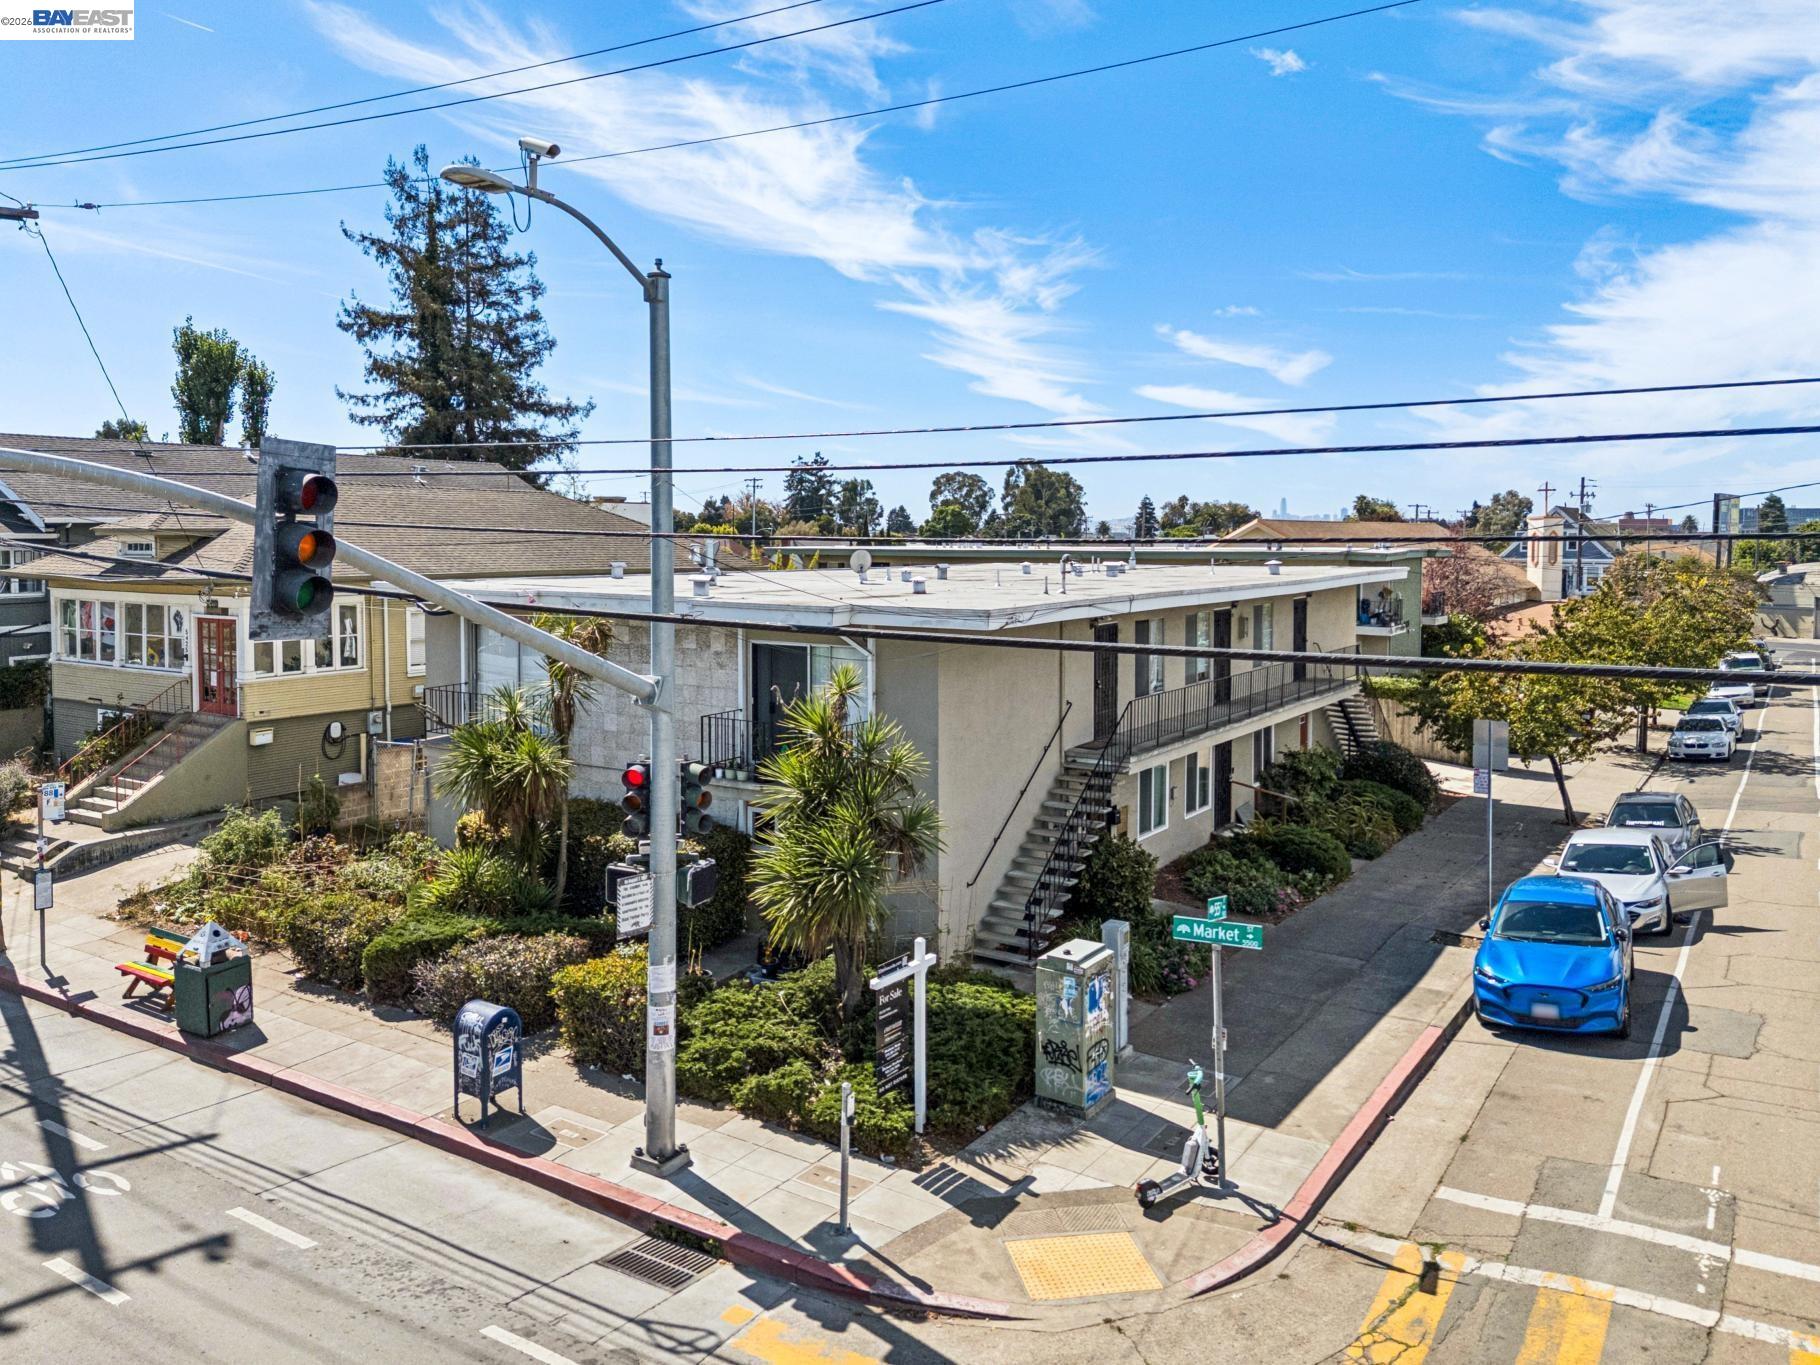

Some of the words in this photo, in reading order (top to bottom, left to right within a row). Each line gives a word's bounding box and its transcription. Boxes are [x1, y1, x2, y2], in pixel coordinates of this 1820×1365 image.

[43, 789, 54, 797] 88
[1193, 923, 1240, 942] Market
[879, 994, 890, 1005] For
[890, 987, 903, 1001] Sale
